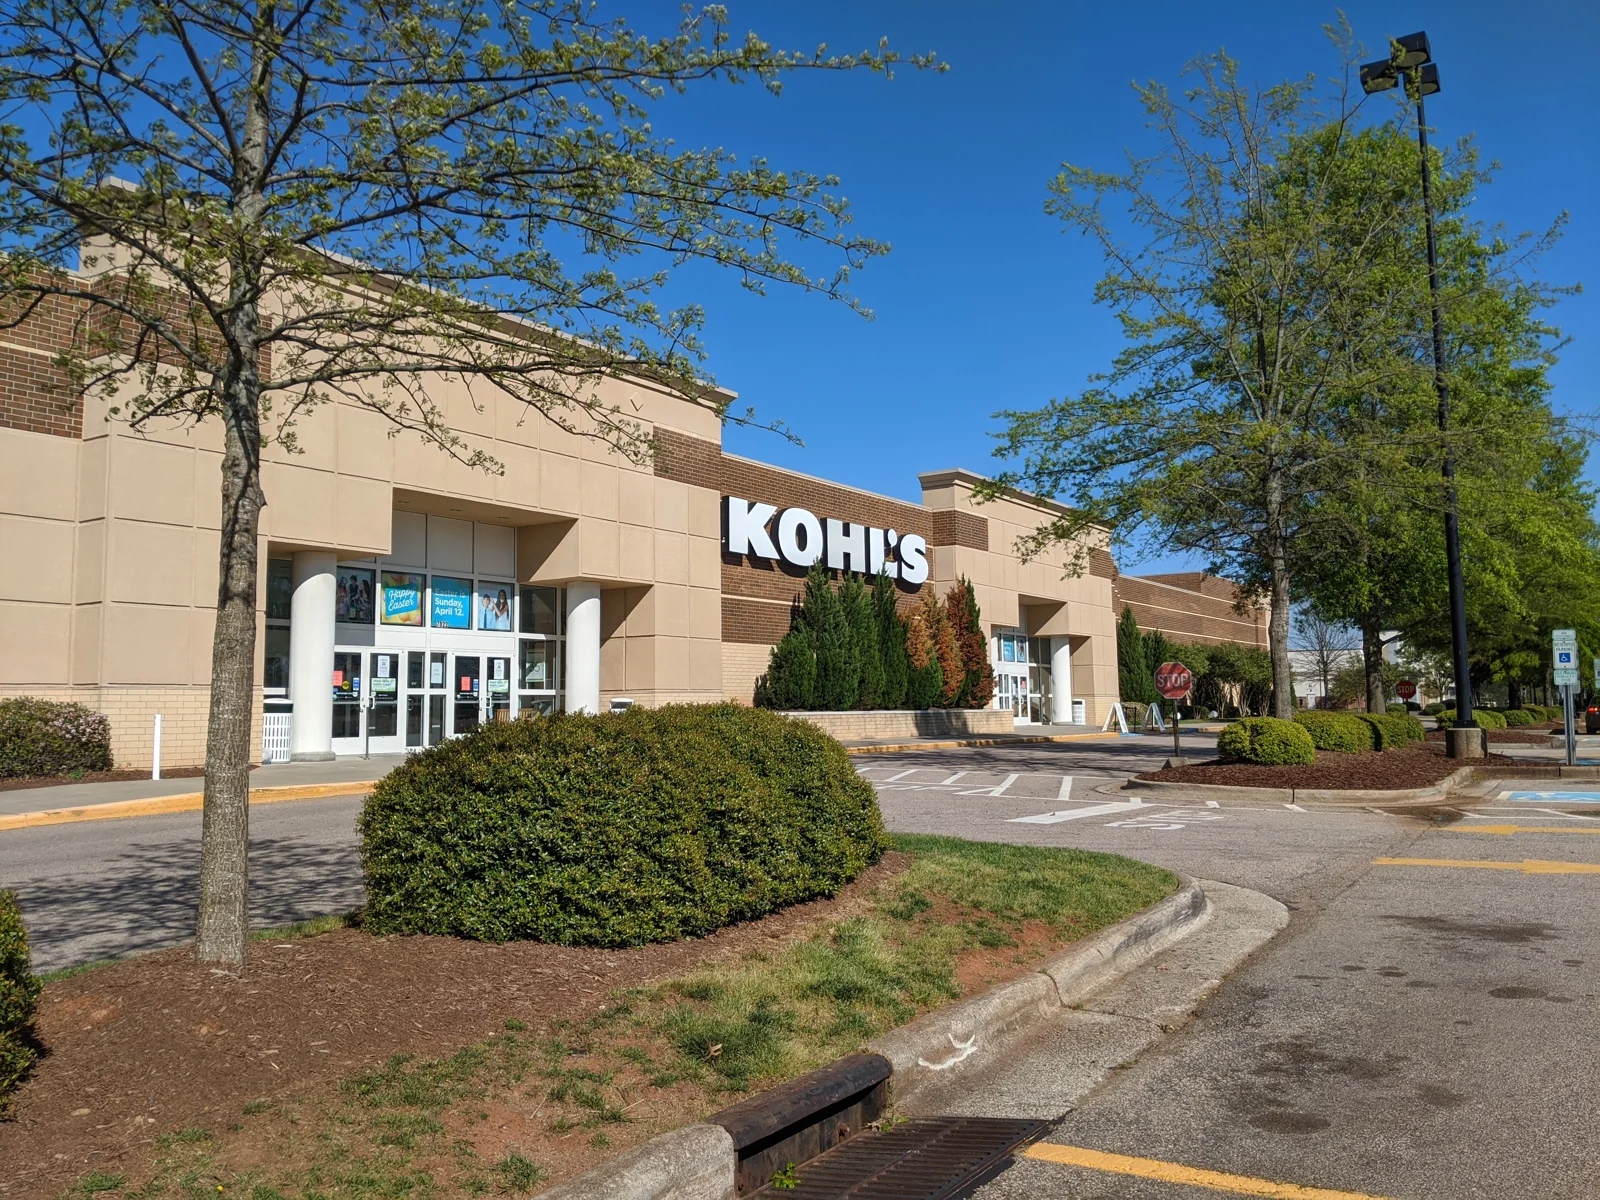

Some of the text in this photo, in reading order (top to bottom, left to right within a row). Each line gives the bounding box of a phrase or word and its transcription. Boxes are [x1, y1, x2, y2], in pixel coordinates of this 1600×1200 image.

[729, 496, 929, 584] KOHL'S
[388, 588, 417, 600] Happy
[435, 588, 466, 598] Easter is
[387, 598, 414, 612] Easter
[434, 597, 463, 608] Sunday,
[434, 606, 465, 616] April 12.
[1157, 673, 1188, 688] STOP
[1396, 685, 1415, 694] STOP
